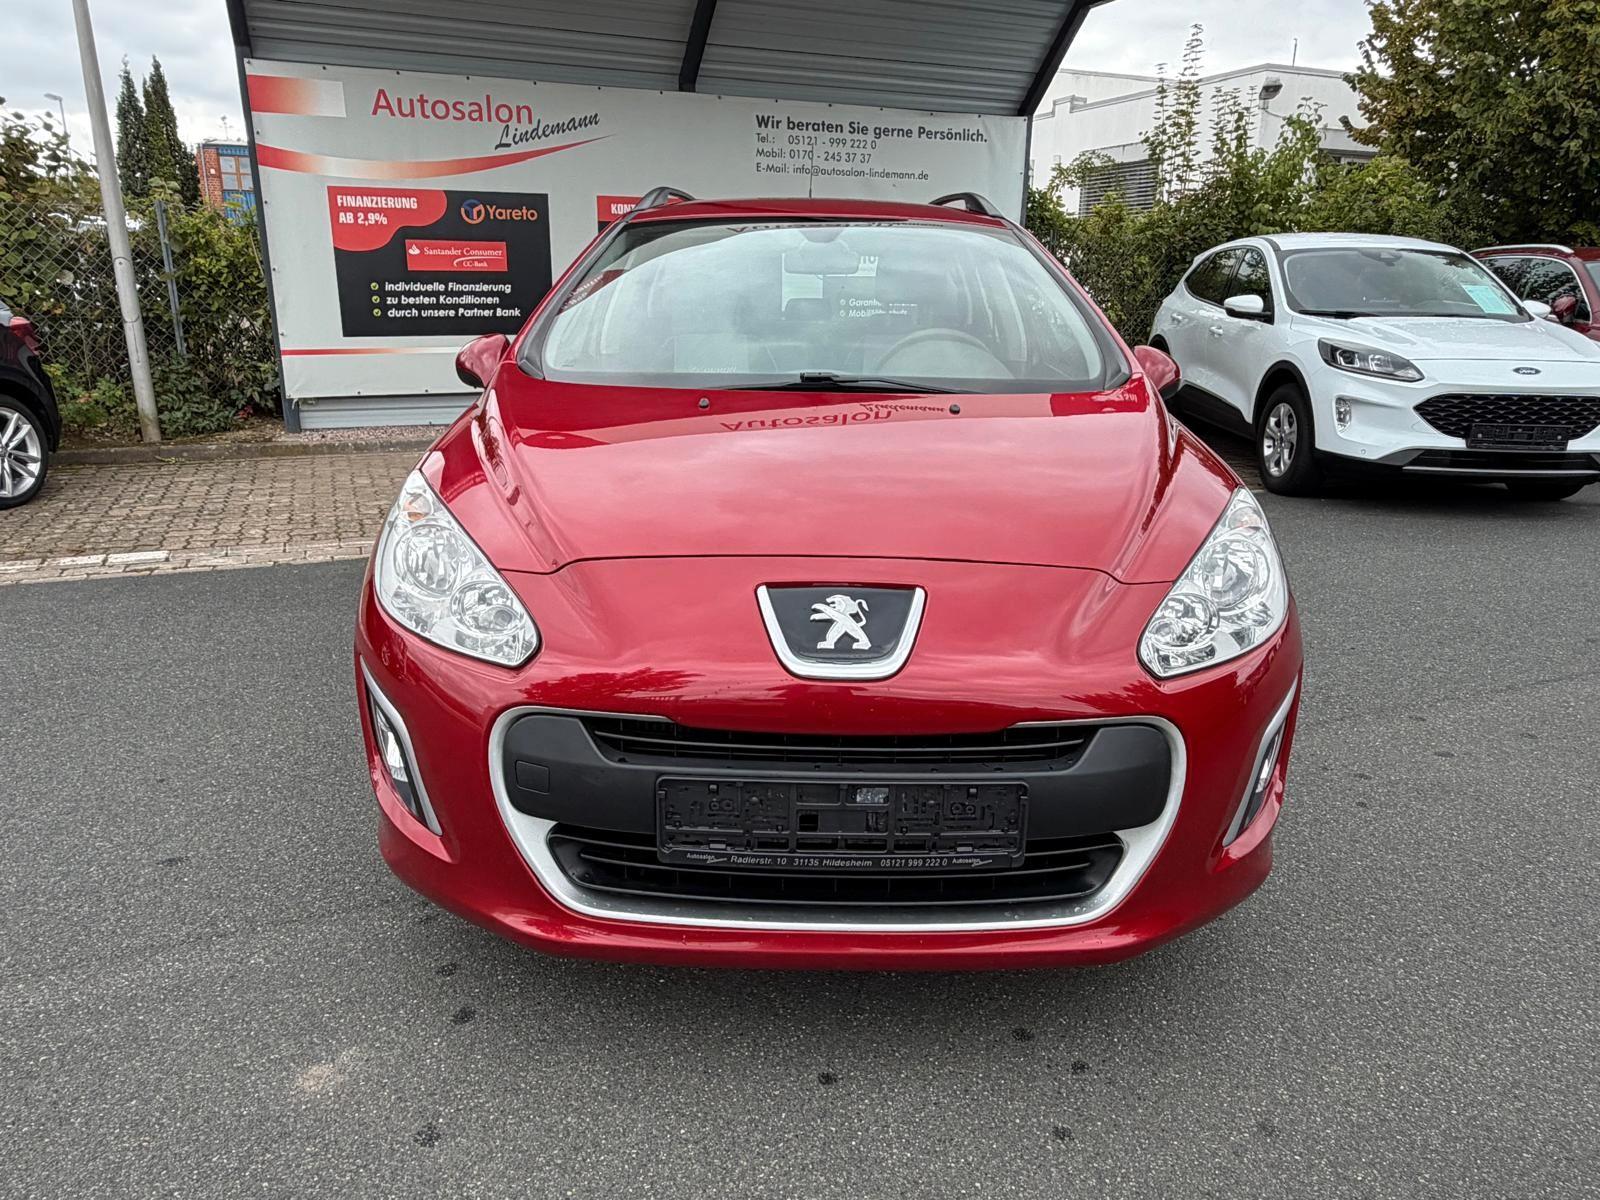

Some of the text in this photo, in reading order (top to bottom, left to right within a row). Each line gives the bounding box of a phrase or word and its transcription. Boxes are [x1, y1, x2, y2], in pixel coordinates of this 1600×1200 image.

[371, 88, 533, 125] Autosalon
[495, 112, 600, 150] Lindemann
[755, 114, 988, 143] Wir beraten Sie gerne Persönlich.
[756, 133, 776, 144] Tel.:
[788, 135, 818, 147] 05121
[829, 137, 847, 148] 999
[849, 139, 869, 150] 222
[870, 140, 877, 150] 0
[755, 148, 786, 159] Mobil:
[789, 149, 814, 161] 0170
[823, 151, 842, 163] 245
[844, 152, 857, 164] 37
[860, 153, 872, 165] 37
[756, 162, 929, 181] E-Mail: info@autosalon-lindemann.de
[337, 195, 418, 210] FINANZIERUNG
[339, 212, 388, 226] AB 2,9%
[485, 205, 538, 221] Yareto
[424, 247, 503, 256] Santander Consumer
[448, 282, 512, 294] Finanzierung
[386, 295, 500, 305] zu besten Konditionen
[387, 308, 521, 317] durch unsere Partner Bank
[777, 857, 787, 865] 10
[793, 858, 820, 866] 31135
[822, 858, 873, 867] Hildesheim
[880, 858, 906, 867] 05121
[907, 859, 923, 867] 999
[925, 858, 941, 867] 222
[942, 858, 948, 866] 0
